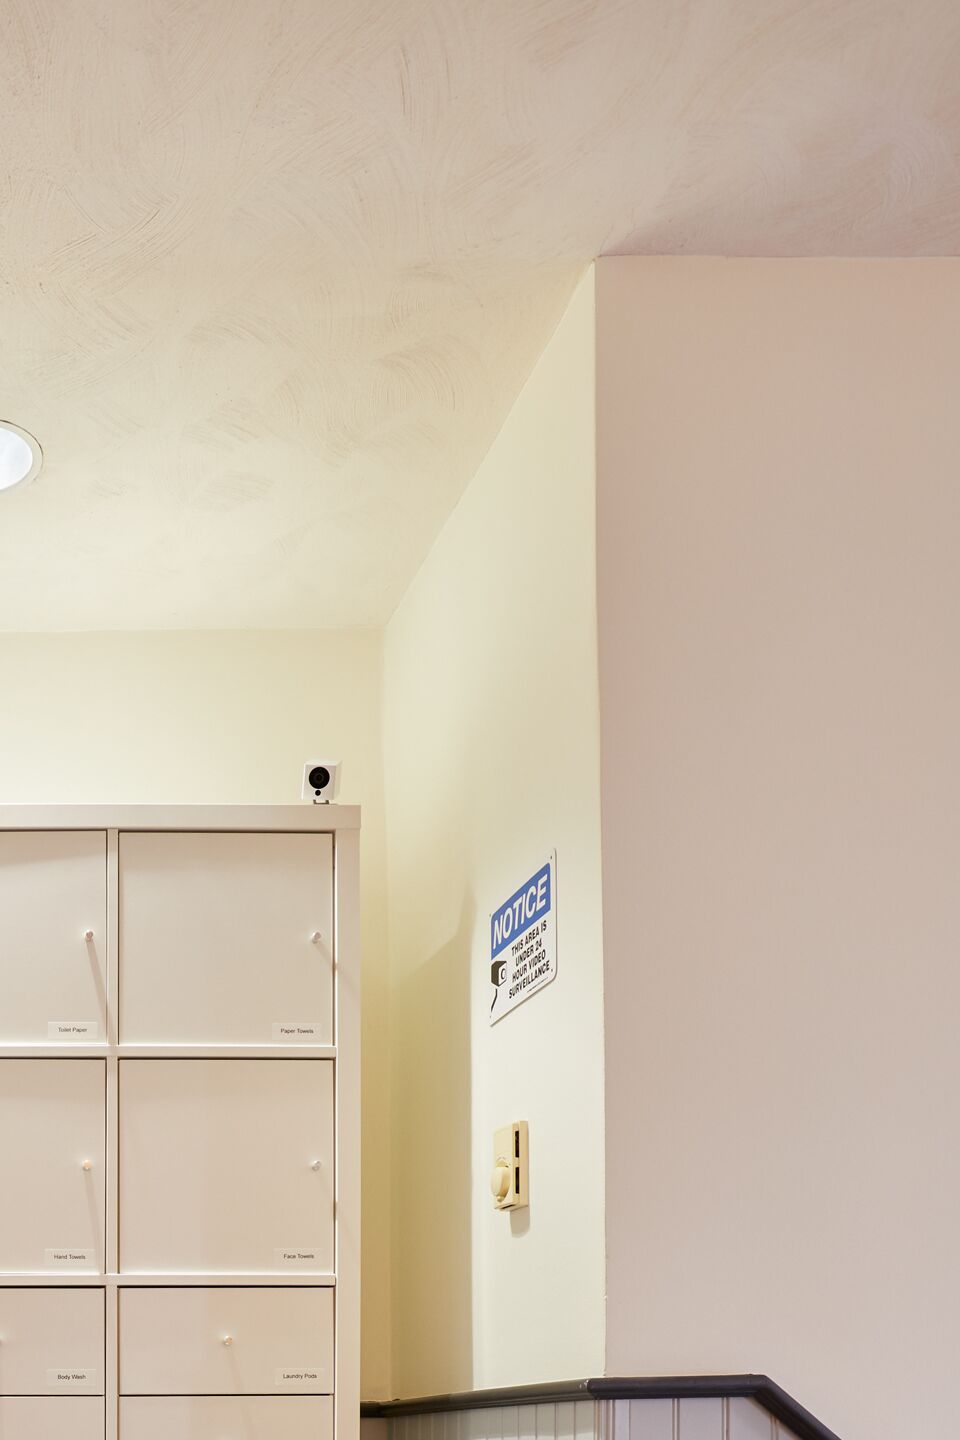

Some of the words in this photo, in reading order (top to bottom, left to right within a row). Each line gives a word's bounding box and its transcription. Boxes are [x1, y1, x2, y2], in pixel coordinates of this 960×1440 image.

[492, 873, 548, 950] NOTICE
[511, 939, 524, 956] THIS
[525, 926, 540, 946] AREA
[540, 919, 547, 933] IS
[515, 944, 534, 967] UNDER
[535, 937, 543, 951] 24
[508, 959, 550, 999] SURVEILLANCE
[512, 963, 528, 982] HOUR
[528, 949, 546, 970] VIDEO
